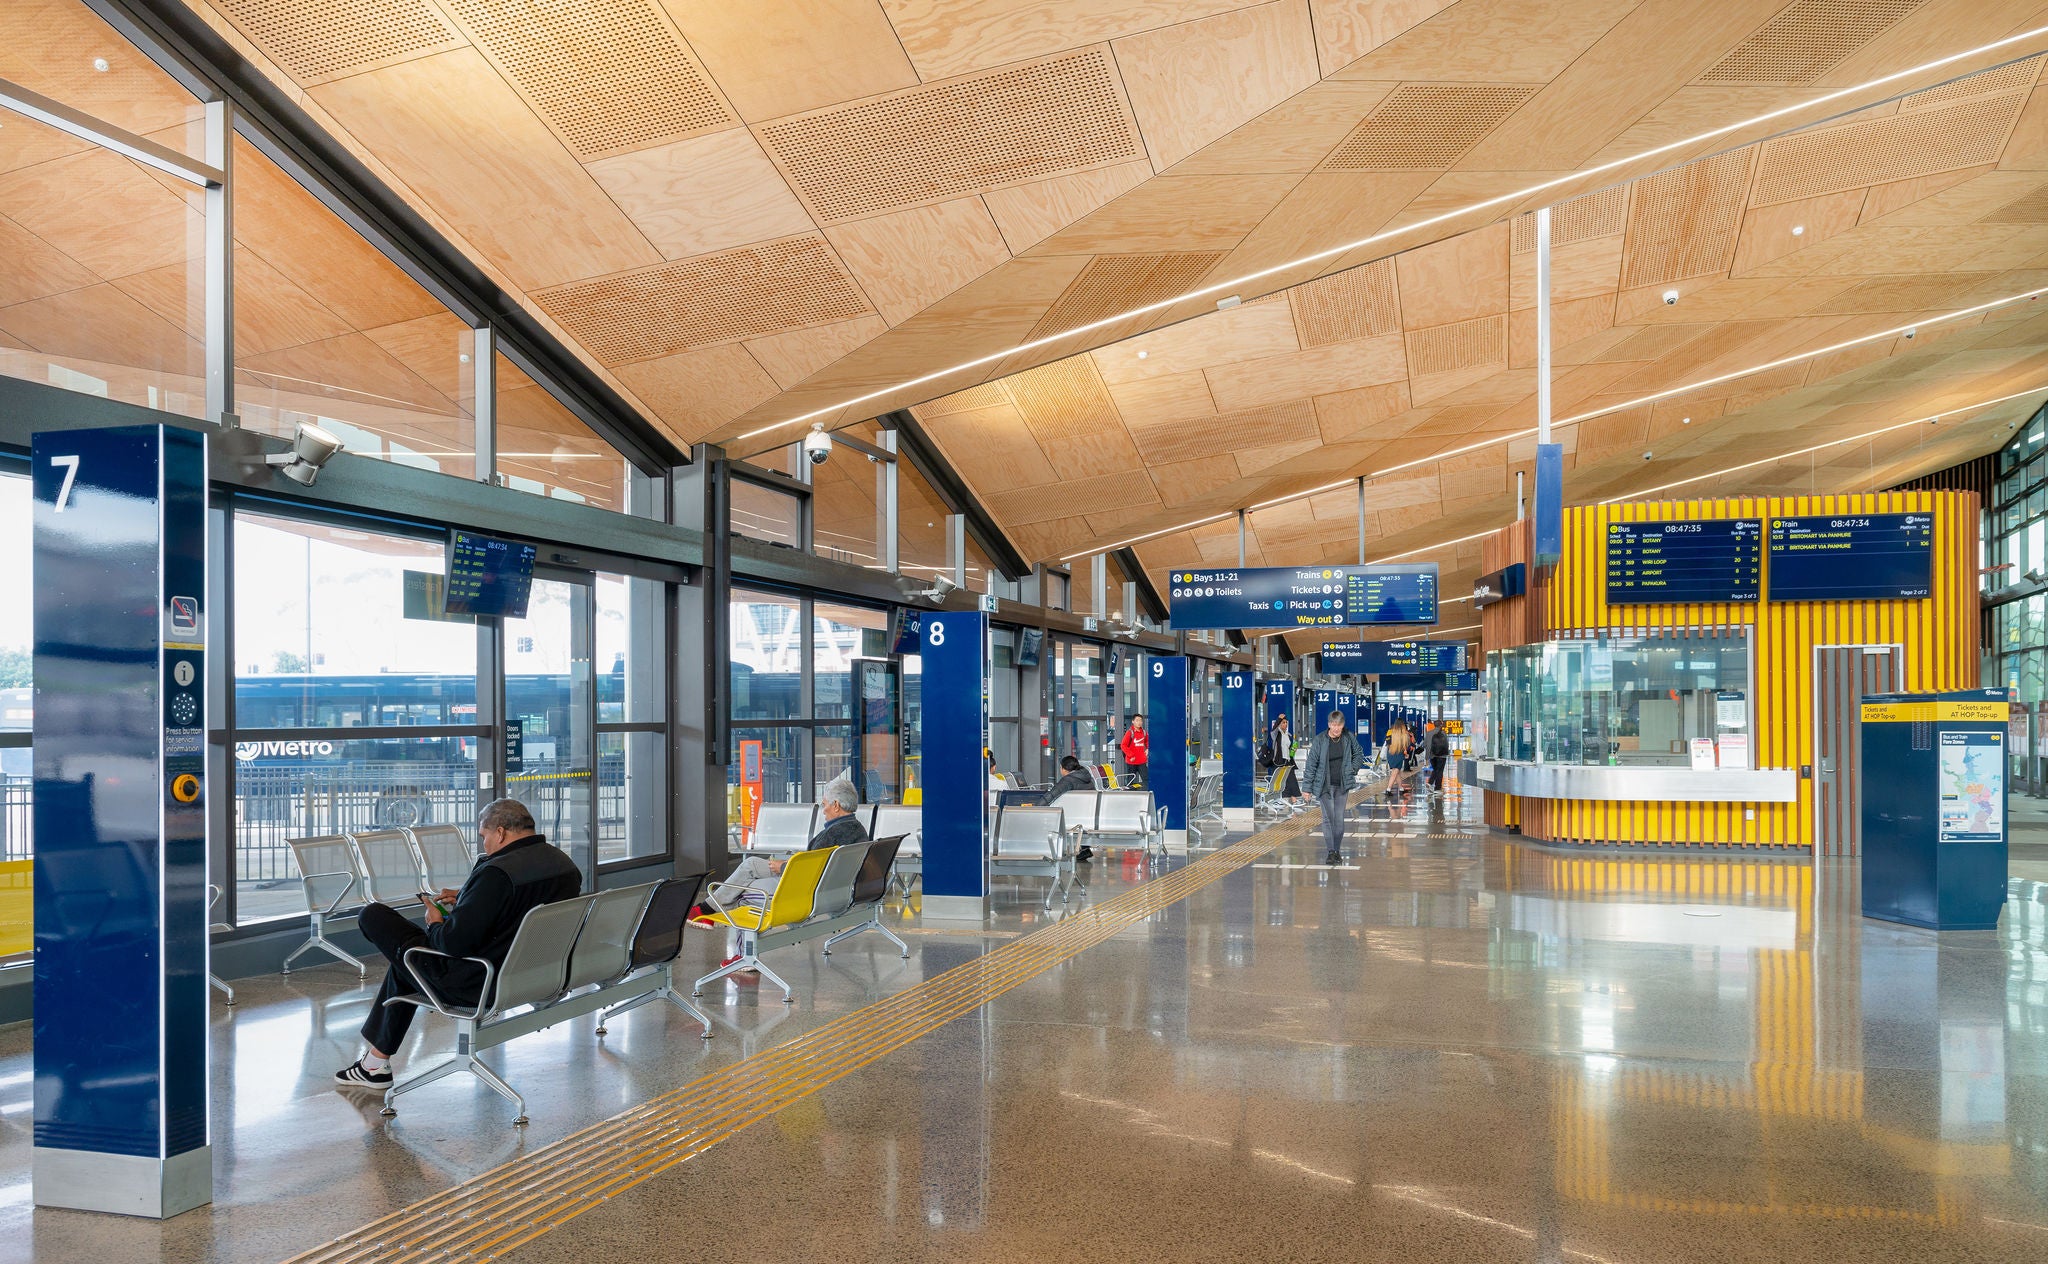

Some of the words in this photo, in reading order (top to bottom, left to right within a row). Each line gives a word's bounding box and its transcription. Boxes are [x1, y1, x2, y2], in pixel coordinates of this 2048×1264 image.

[51, 455, 80, 513] 7
[1831, 519, 1869, 528] 08:47:34
[1194, 574, 1213, 583] Bays
[1215, 573, 1238, 581] 11-21
[1296, 571, 1320, 579] Trains
[1215, 588, 1242, 596] Toilets
[1291, 586, 1320, 594] Tickets
[1249, 601, 1269, 610] Taxis
[1290, 600, 1308, 609] Pick
[1310, 602, 1320, 610] up
[1297, 616, 1315, 625] Way
[1317, 616, 1332, 624] out
[930, 622, 944, 646] 8
[1153, 662, 1163, 678] 9
[1226, 676, 1242, 688] 10
[1271, 684, 1284, 694] 11
[1318, 693, 1329, 701] 12
[166, 736, 174, 744] for
[263, 741, 332, 756] Metro
